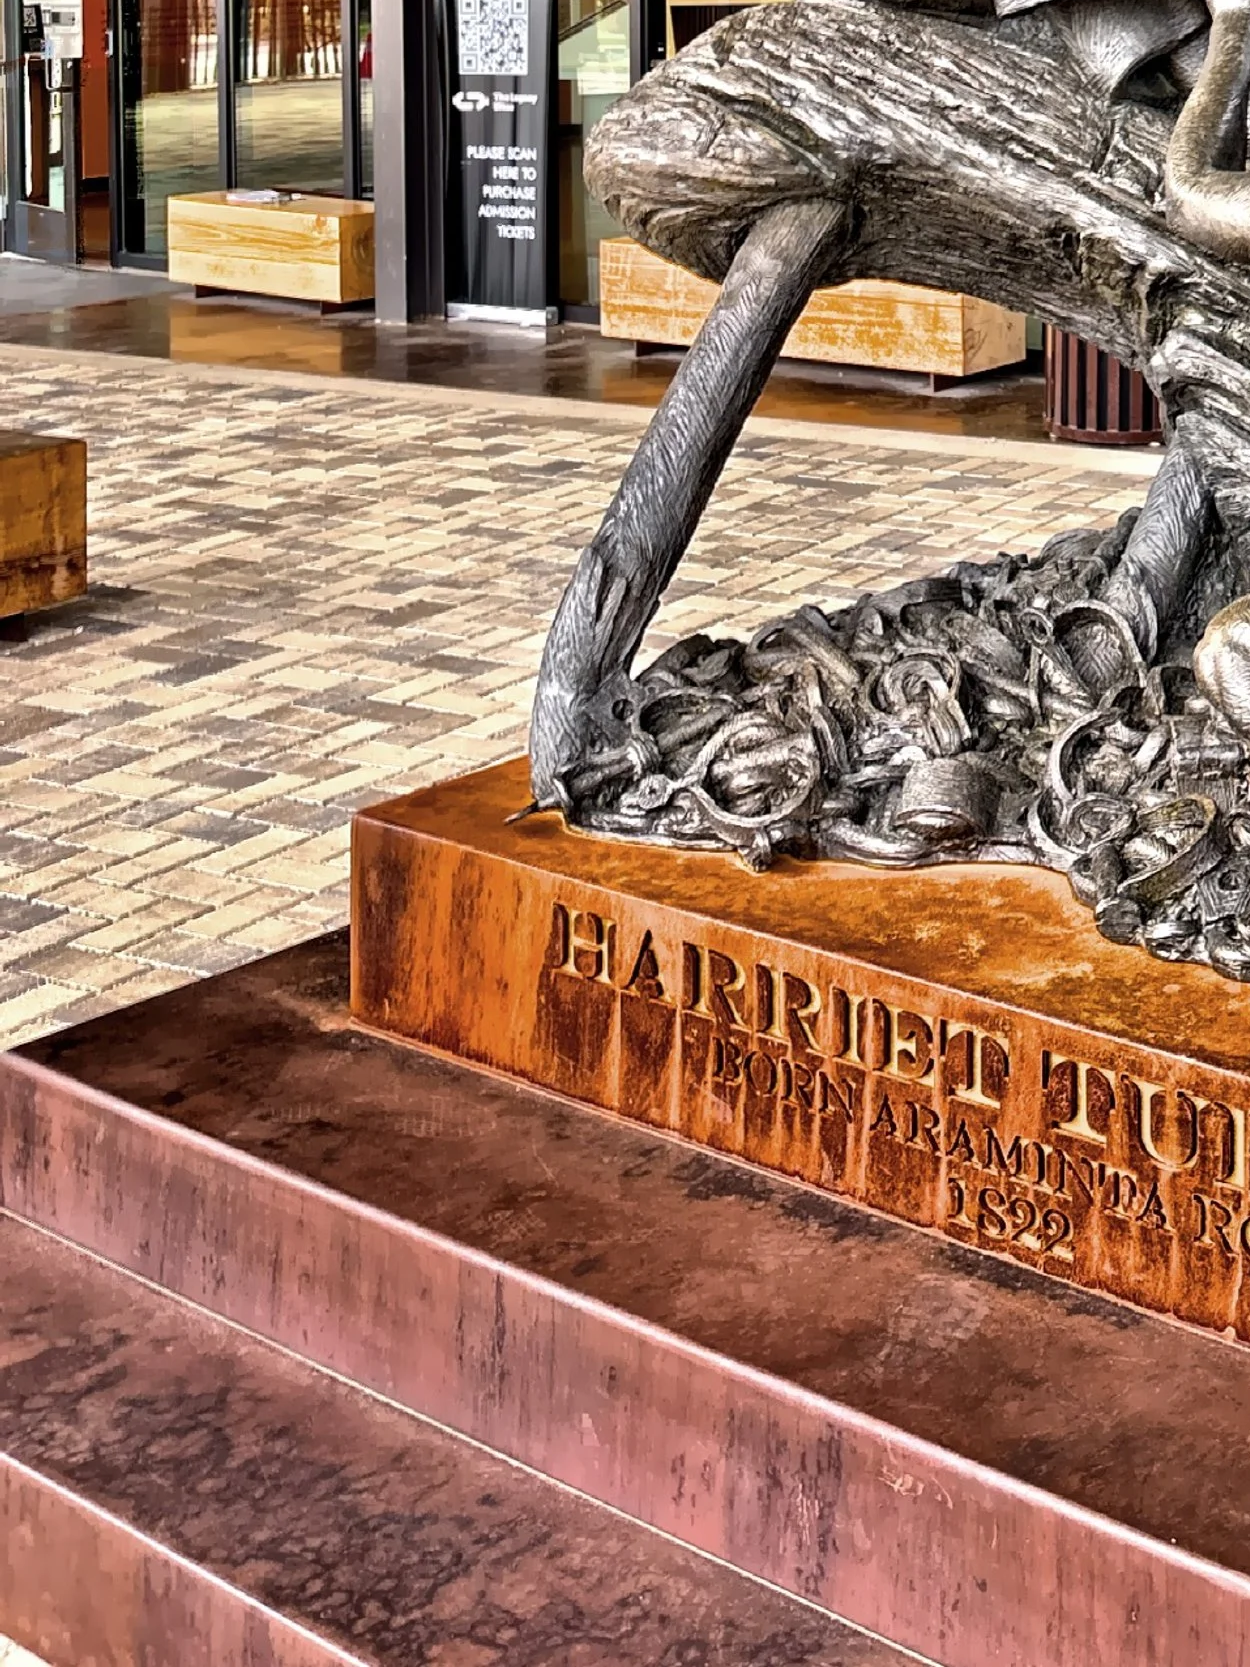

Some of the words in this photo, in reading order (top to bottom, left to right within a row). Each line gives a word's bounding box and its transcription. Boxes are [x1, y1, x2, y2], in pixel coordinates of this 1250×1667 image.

[466, 145, 505, 160] PLEASE
[508, 146, 537, 161] SCAN
[493, 166, 519, 180] HERE
[521, 166, 537, 181] TO
[482, 184, 537, 201] PURCHASE
[478, 204, 536, 220] ADMISSION
[496, 224, 536, 240] TICKETS
[551, 902, 1010, 1109] HARRIET
[712, 1036, 857, 1124] BORN
[869, 1093, 1175, 1234] ARAMINTA
[947, 1176, 1076, 1262] 1822
